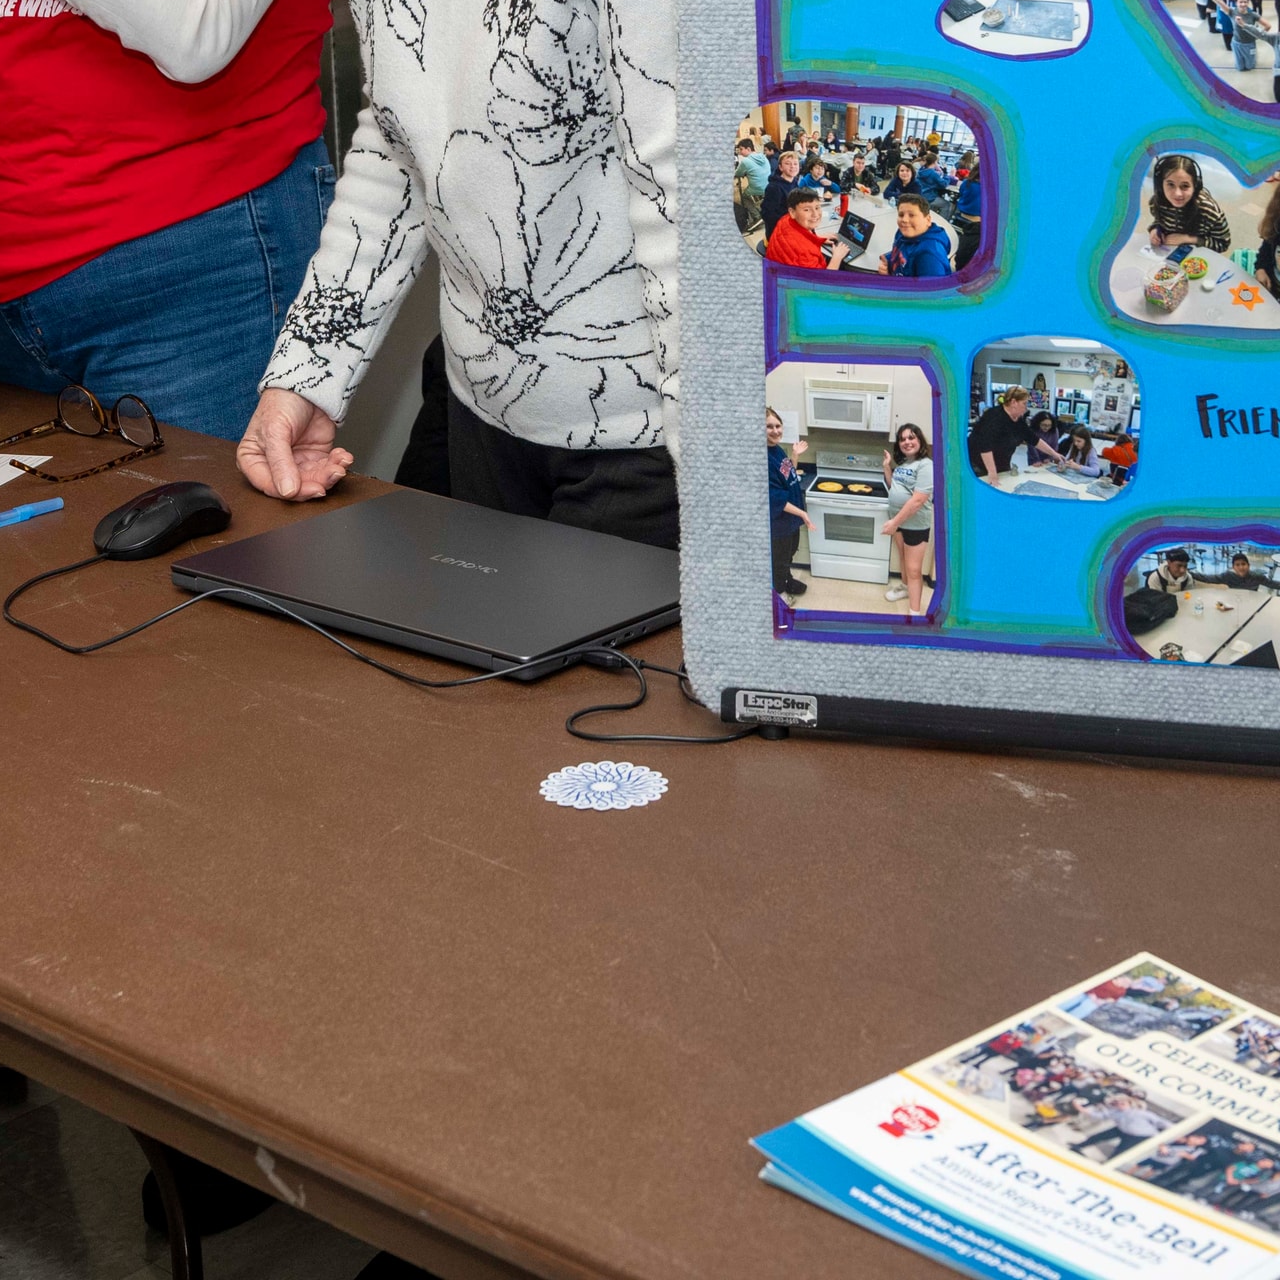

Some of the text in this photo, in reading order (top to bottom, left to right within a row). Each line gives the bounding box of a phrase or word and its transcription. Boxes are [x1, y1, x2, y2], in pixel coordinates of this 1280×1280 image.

[744, 694, 812, 710] ExpoStar
[1096, 1043, 1158, 1079] OUR
[957, 1140, 1230, 1267] After-The-Bell
